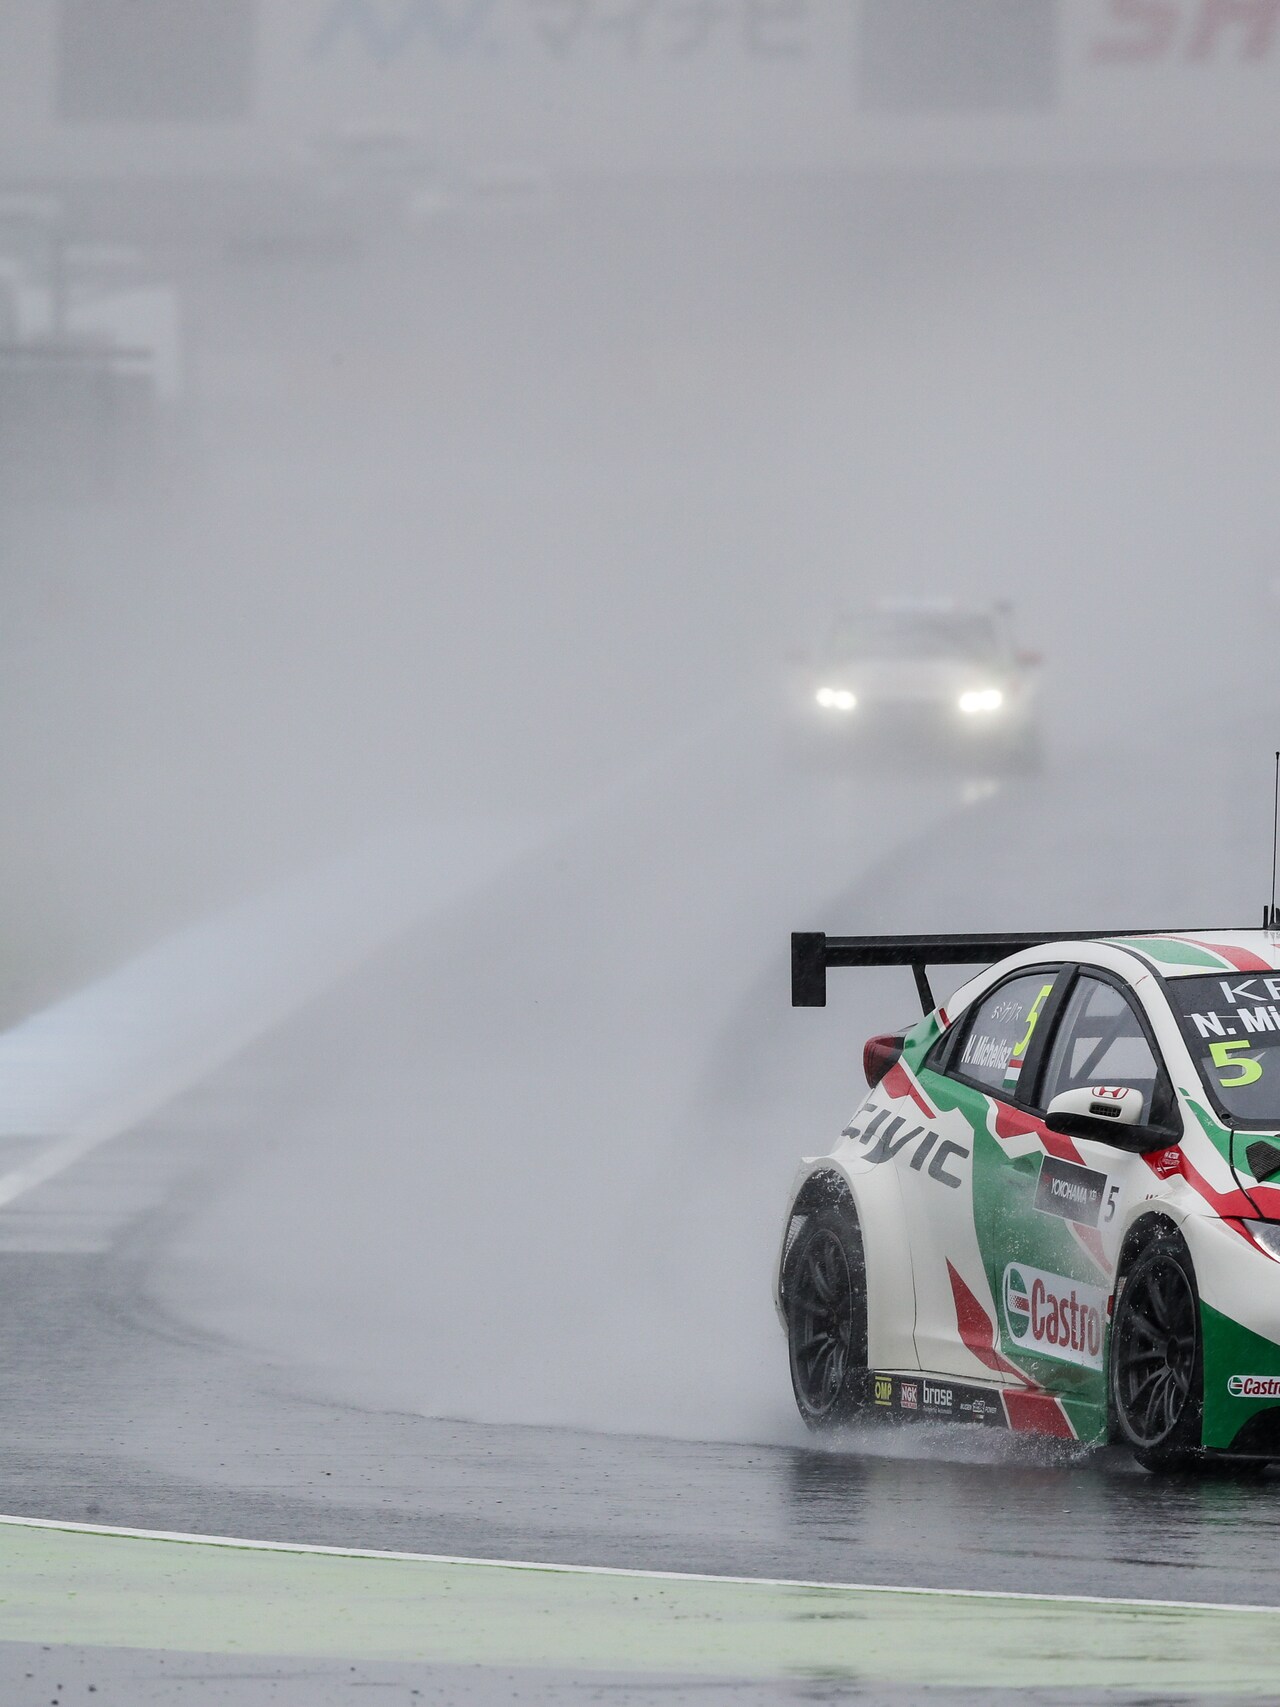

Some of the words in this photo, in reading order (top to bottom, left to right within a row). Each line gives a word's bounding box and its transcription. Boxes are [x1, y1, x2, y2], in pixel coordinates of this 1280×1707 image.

[1013, 984, 1053, 1056] 5
[1191, 1011, 1237, 1038] N.
[961, 1034, 977, 1064] N.
[970, 1035, 1013, 1070] Michelisz
[1208, 1039, 1263, 1087] 5
[1051, 1177, 1088, 1205] YOKOHAMA
[1104, 1185, 1120, 1222] 5
[874, 1381, 892, 1400] OMP
[901, 1385, 917, 1402] NGK
[923, 1380, 953, 1407] brose
